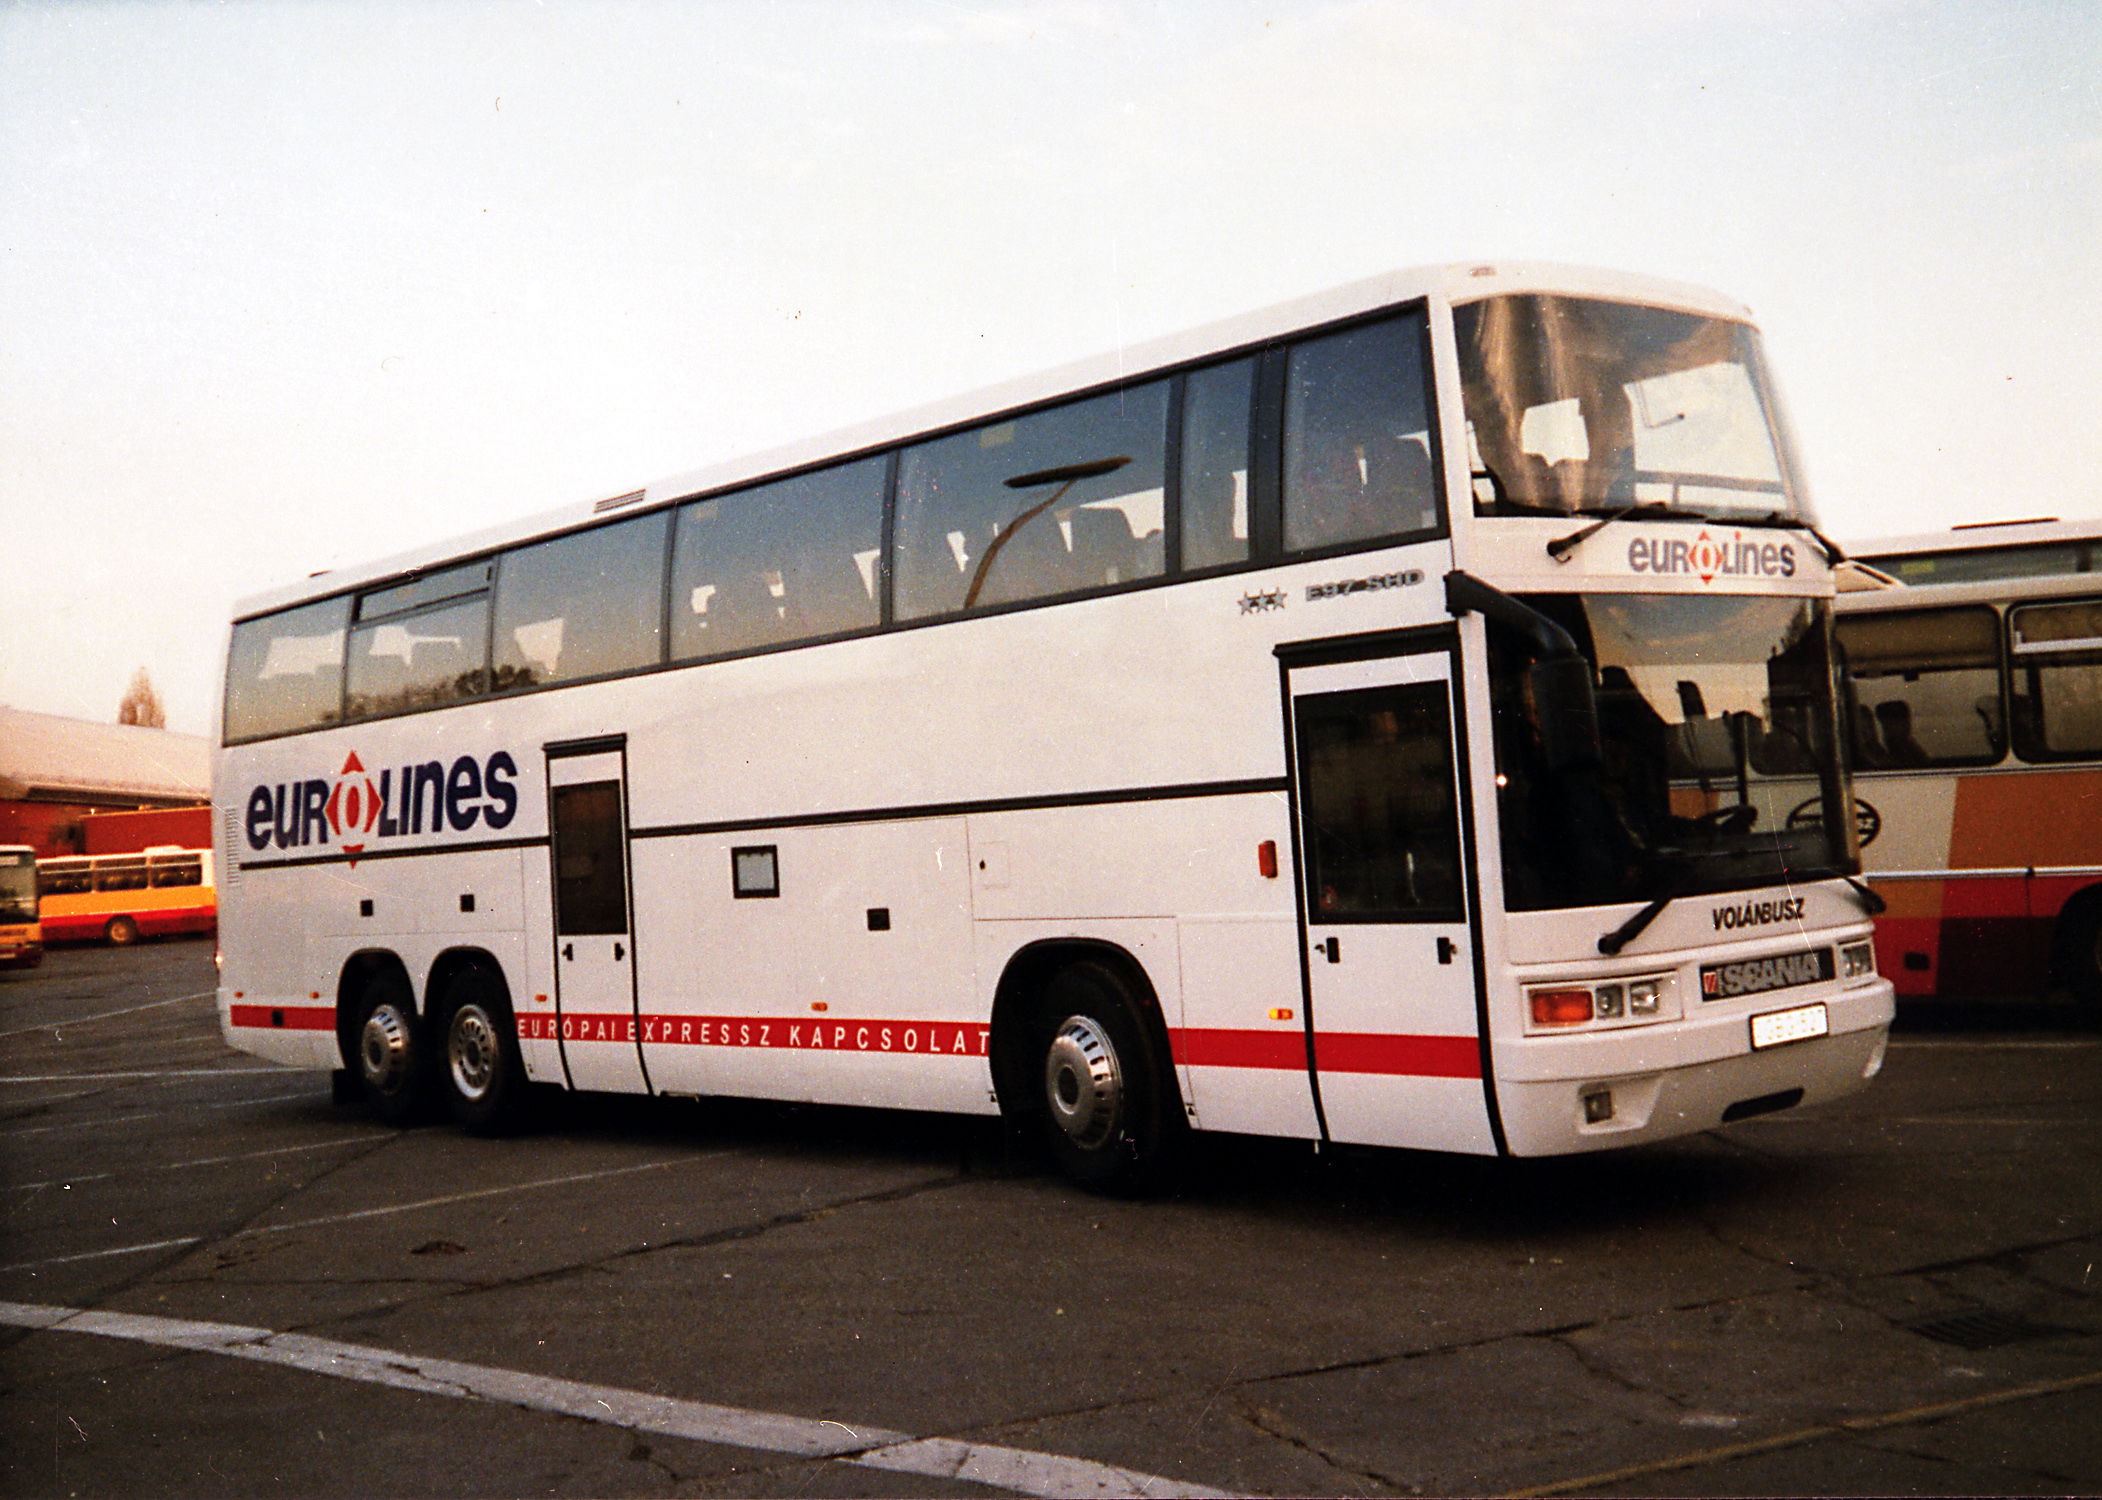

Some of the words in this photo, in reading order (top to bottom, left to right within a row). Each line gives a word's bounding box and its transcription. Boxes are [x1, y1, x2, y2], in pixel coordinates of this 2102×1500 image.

[1713, 898, 1805, 930] VOLÁNBUSZ
[1723, 952, 1822, 995] SCANIA
[517, 1016, 616, 1038] EURÓPAI
[627, 1020, 770, 1046] EXPRESSZ
[789, 1025, 990, 1054] KAPCSOLAT
